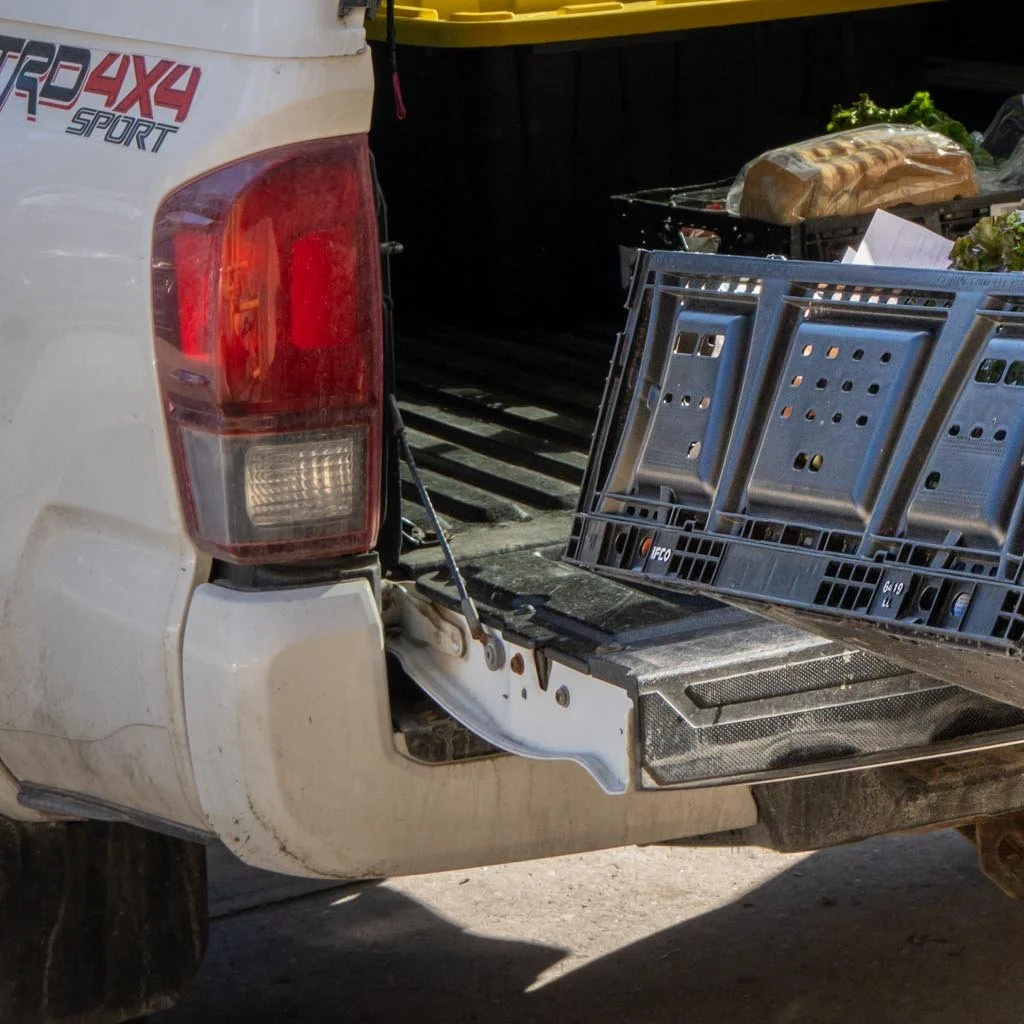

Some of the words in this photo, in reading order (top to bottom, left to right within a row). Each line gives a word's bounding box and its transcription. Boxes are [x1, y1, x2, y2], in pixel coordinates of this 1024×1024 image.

[0, 35, 91, 122] TRD
[65, 107, 180, 153] SPORT
[650, 546, 672, 562] IFCO
